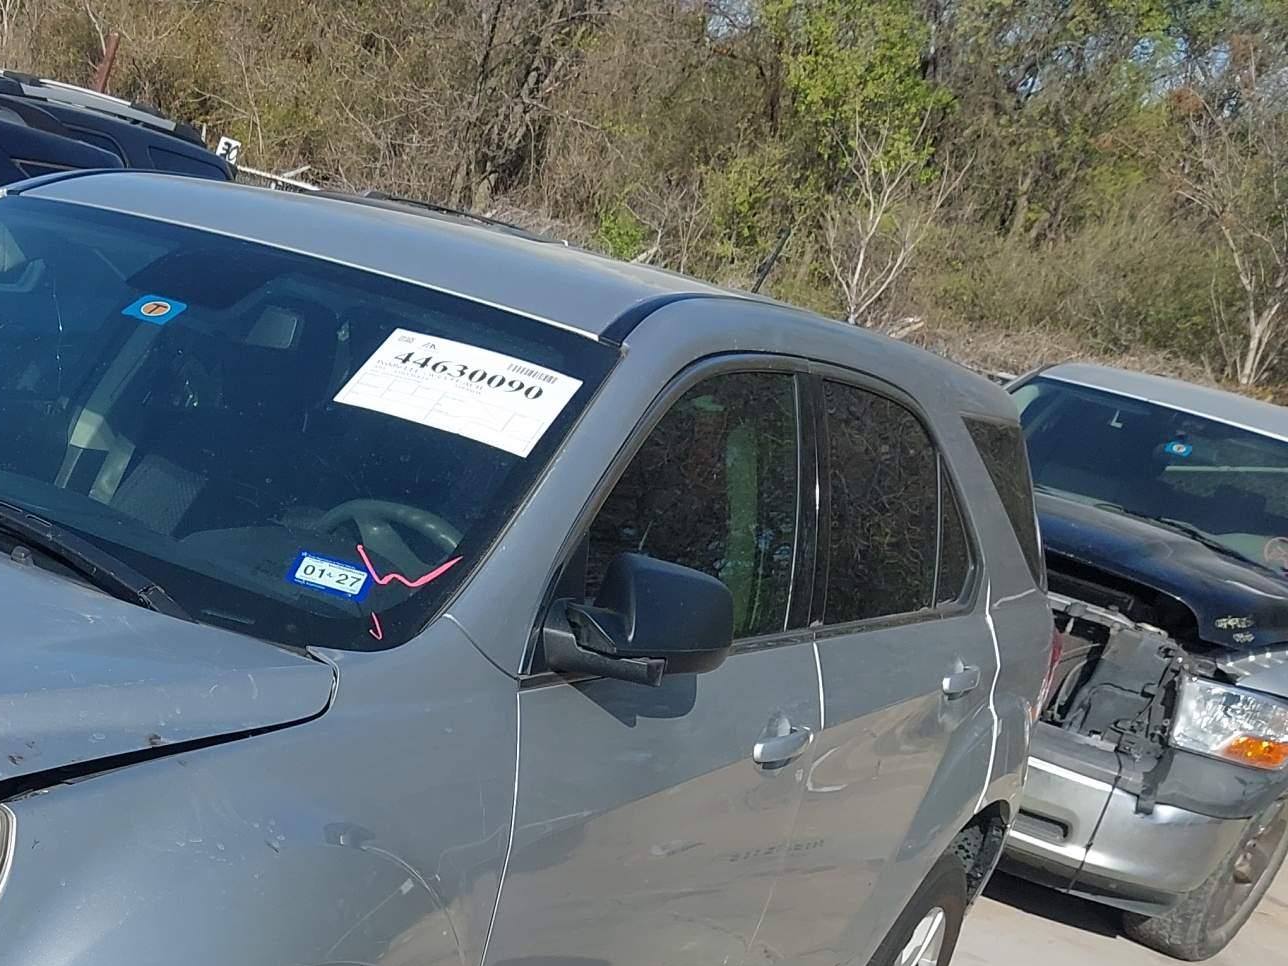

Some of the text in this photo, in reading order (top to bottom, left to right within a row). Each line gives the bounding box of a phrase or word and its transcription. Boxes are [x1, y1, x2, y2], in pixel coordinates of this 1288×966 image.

[394, 351, 544, 400] 44630090
[303, 564, 326, 579] 01
[335, 573, 362, 587] 27
